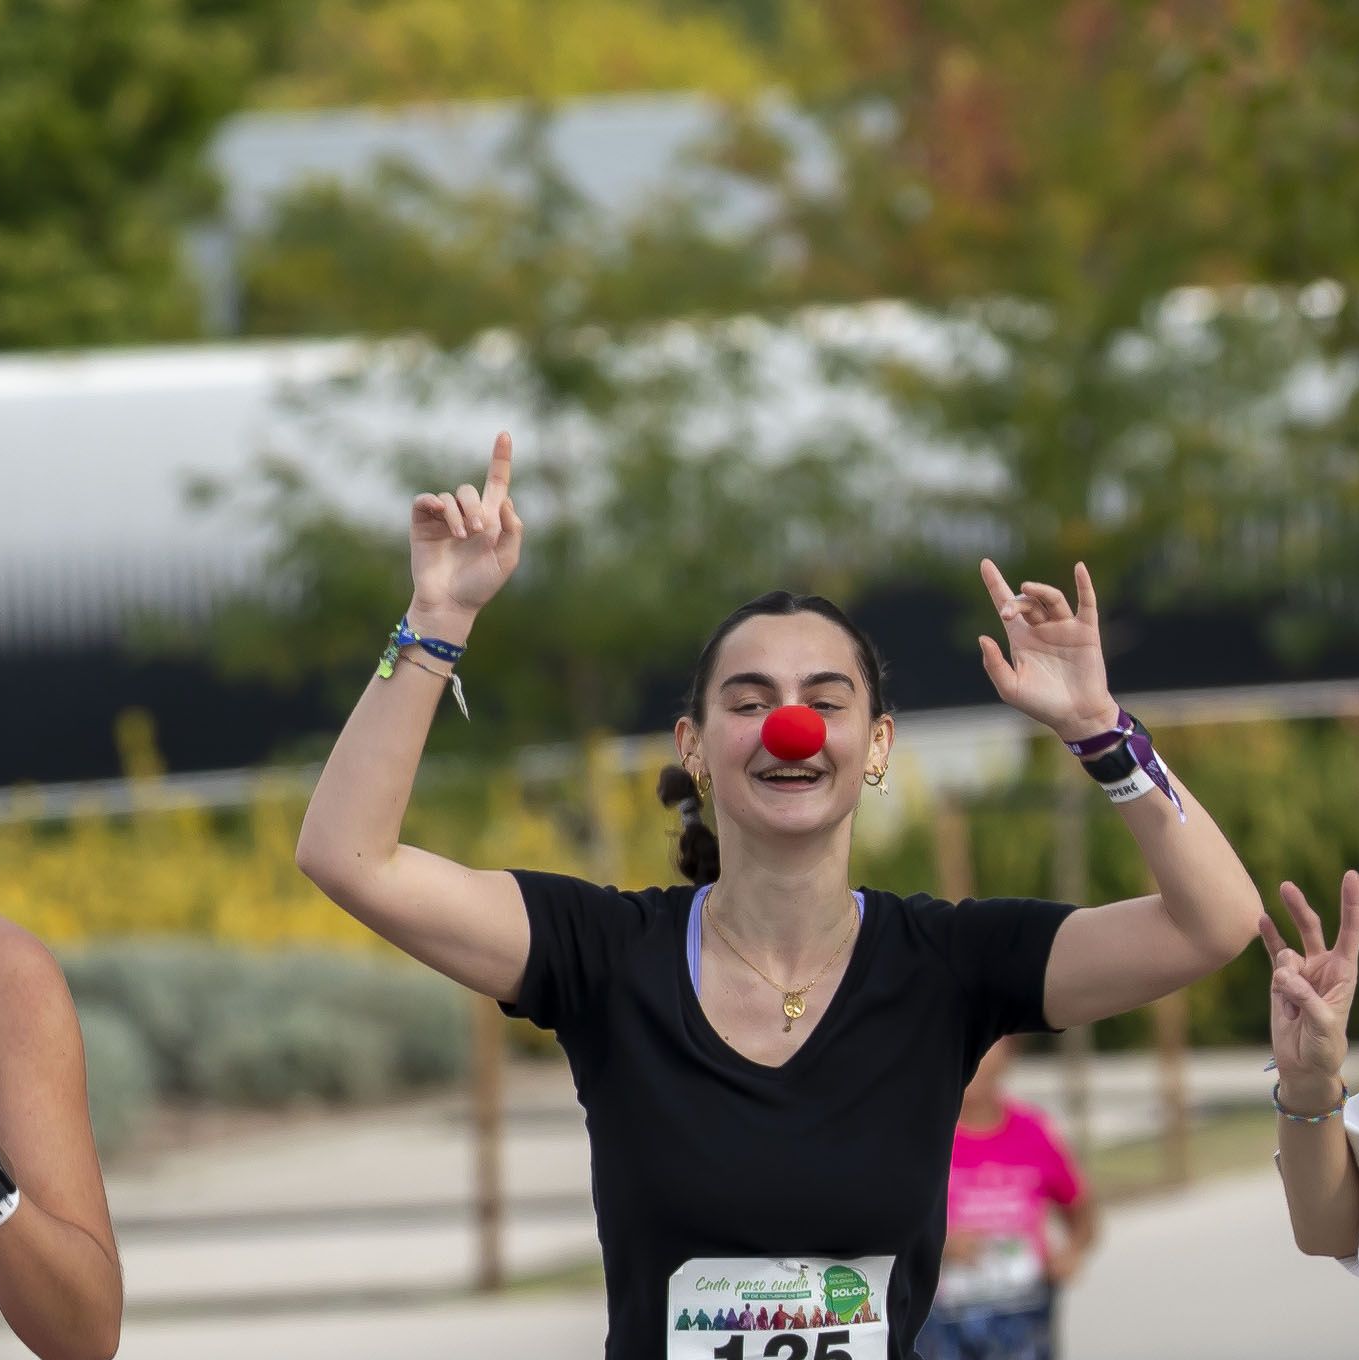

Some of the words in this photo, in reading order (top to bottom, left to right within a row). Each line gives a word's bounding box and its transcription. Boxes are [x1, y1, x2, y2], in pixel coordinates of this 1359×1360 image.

[695, 1276, 730, 1292] Cada
[734, 1279, 767, 1297] paso
[771, 1274, 809, 1291] cuenta
[831, 1286, 868, 1299] DOLOR
